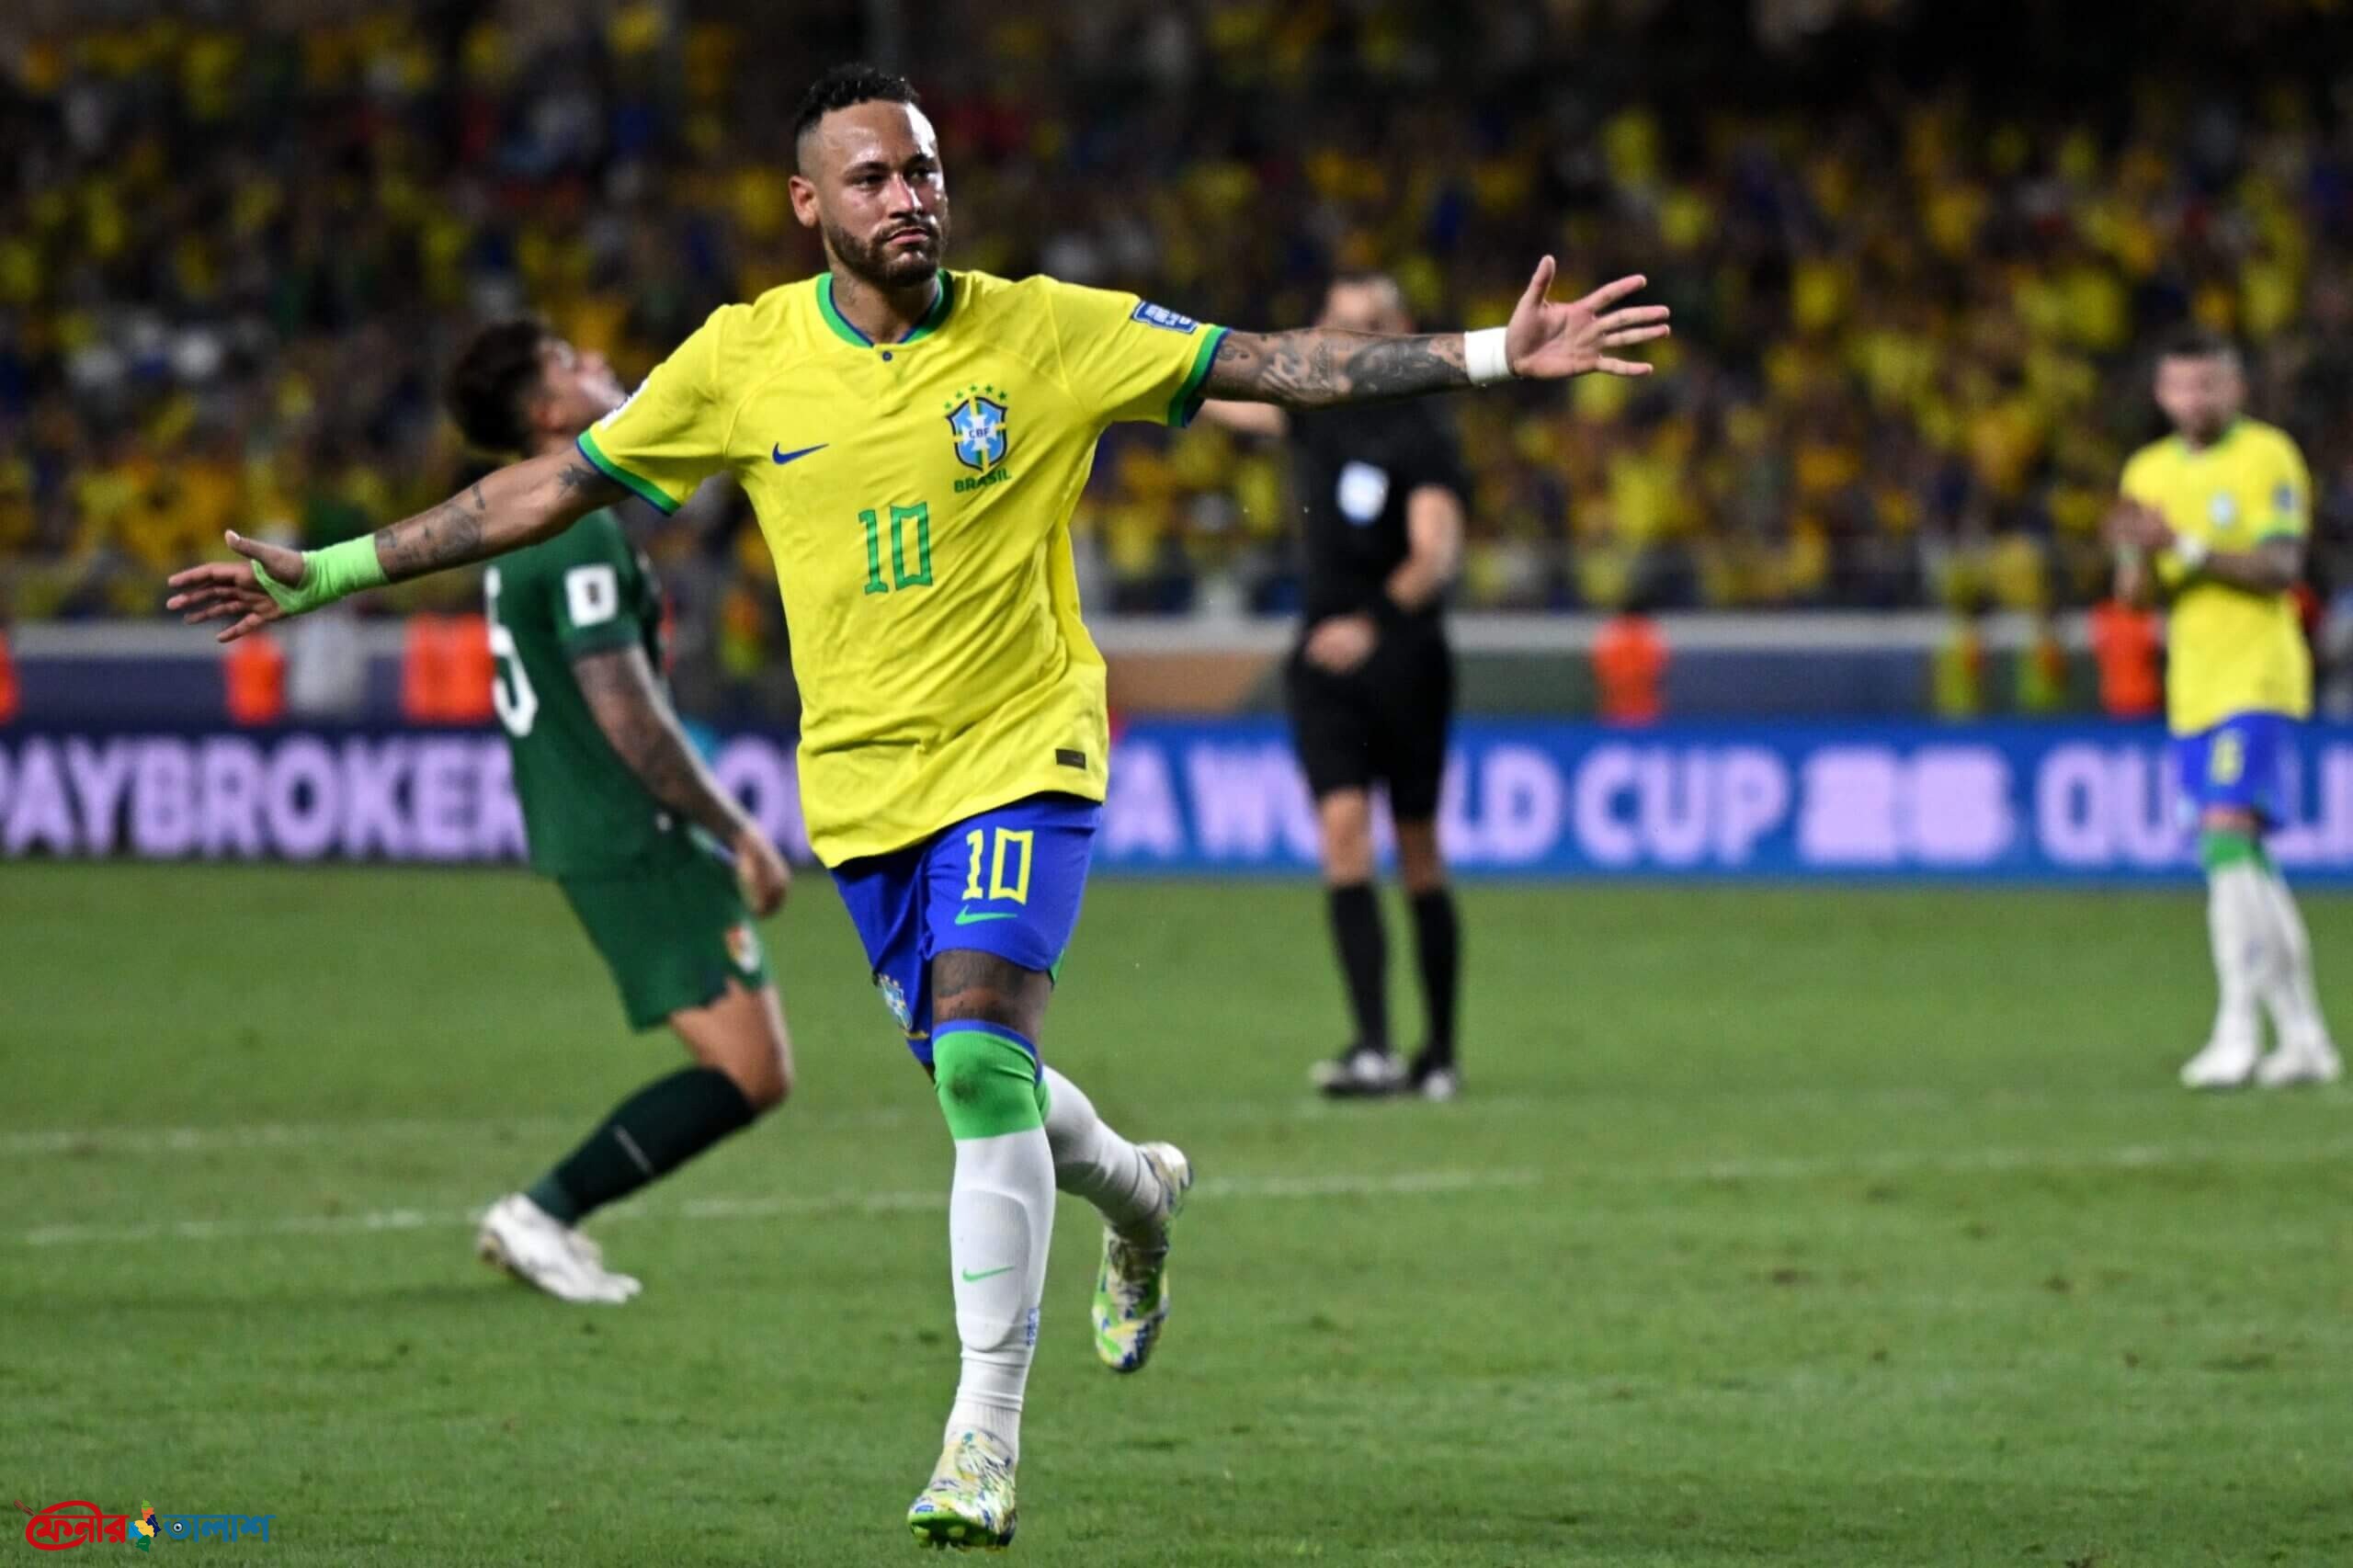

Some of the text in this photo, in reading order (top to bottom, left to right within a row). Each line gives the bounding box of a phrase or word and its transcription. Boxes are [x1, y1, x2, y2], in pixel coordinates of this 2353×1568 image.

[969, 426, 990, 439] CBF
[954, 468, 1012, 493] BRASIL
[858, 502, 934, 596] 10
[0, 736, 530, 860] AYBROKER
[1188, 740, 1560, 864] WLD
[1574, 743, 1789, 867] CUP
[961, 826, 1034, 905] 10
